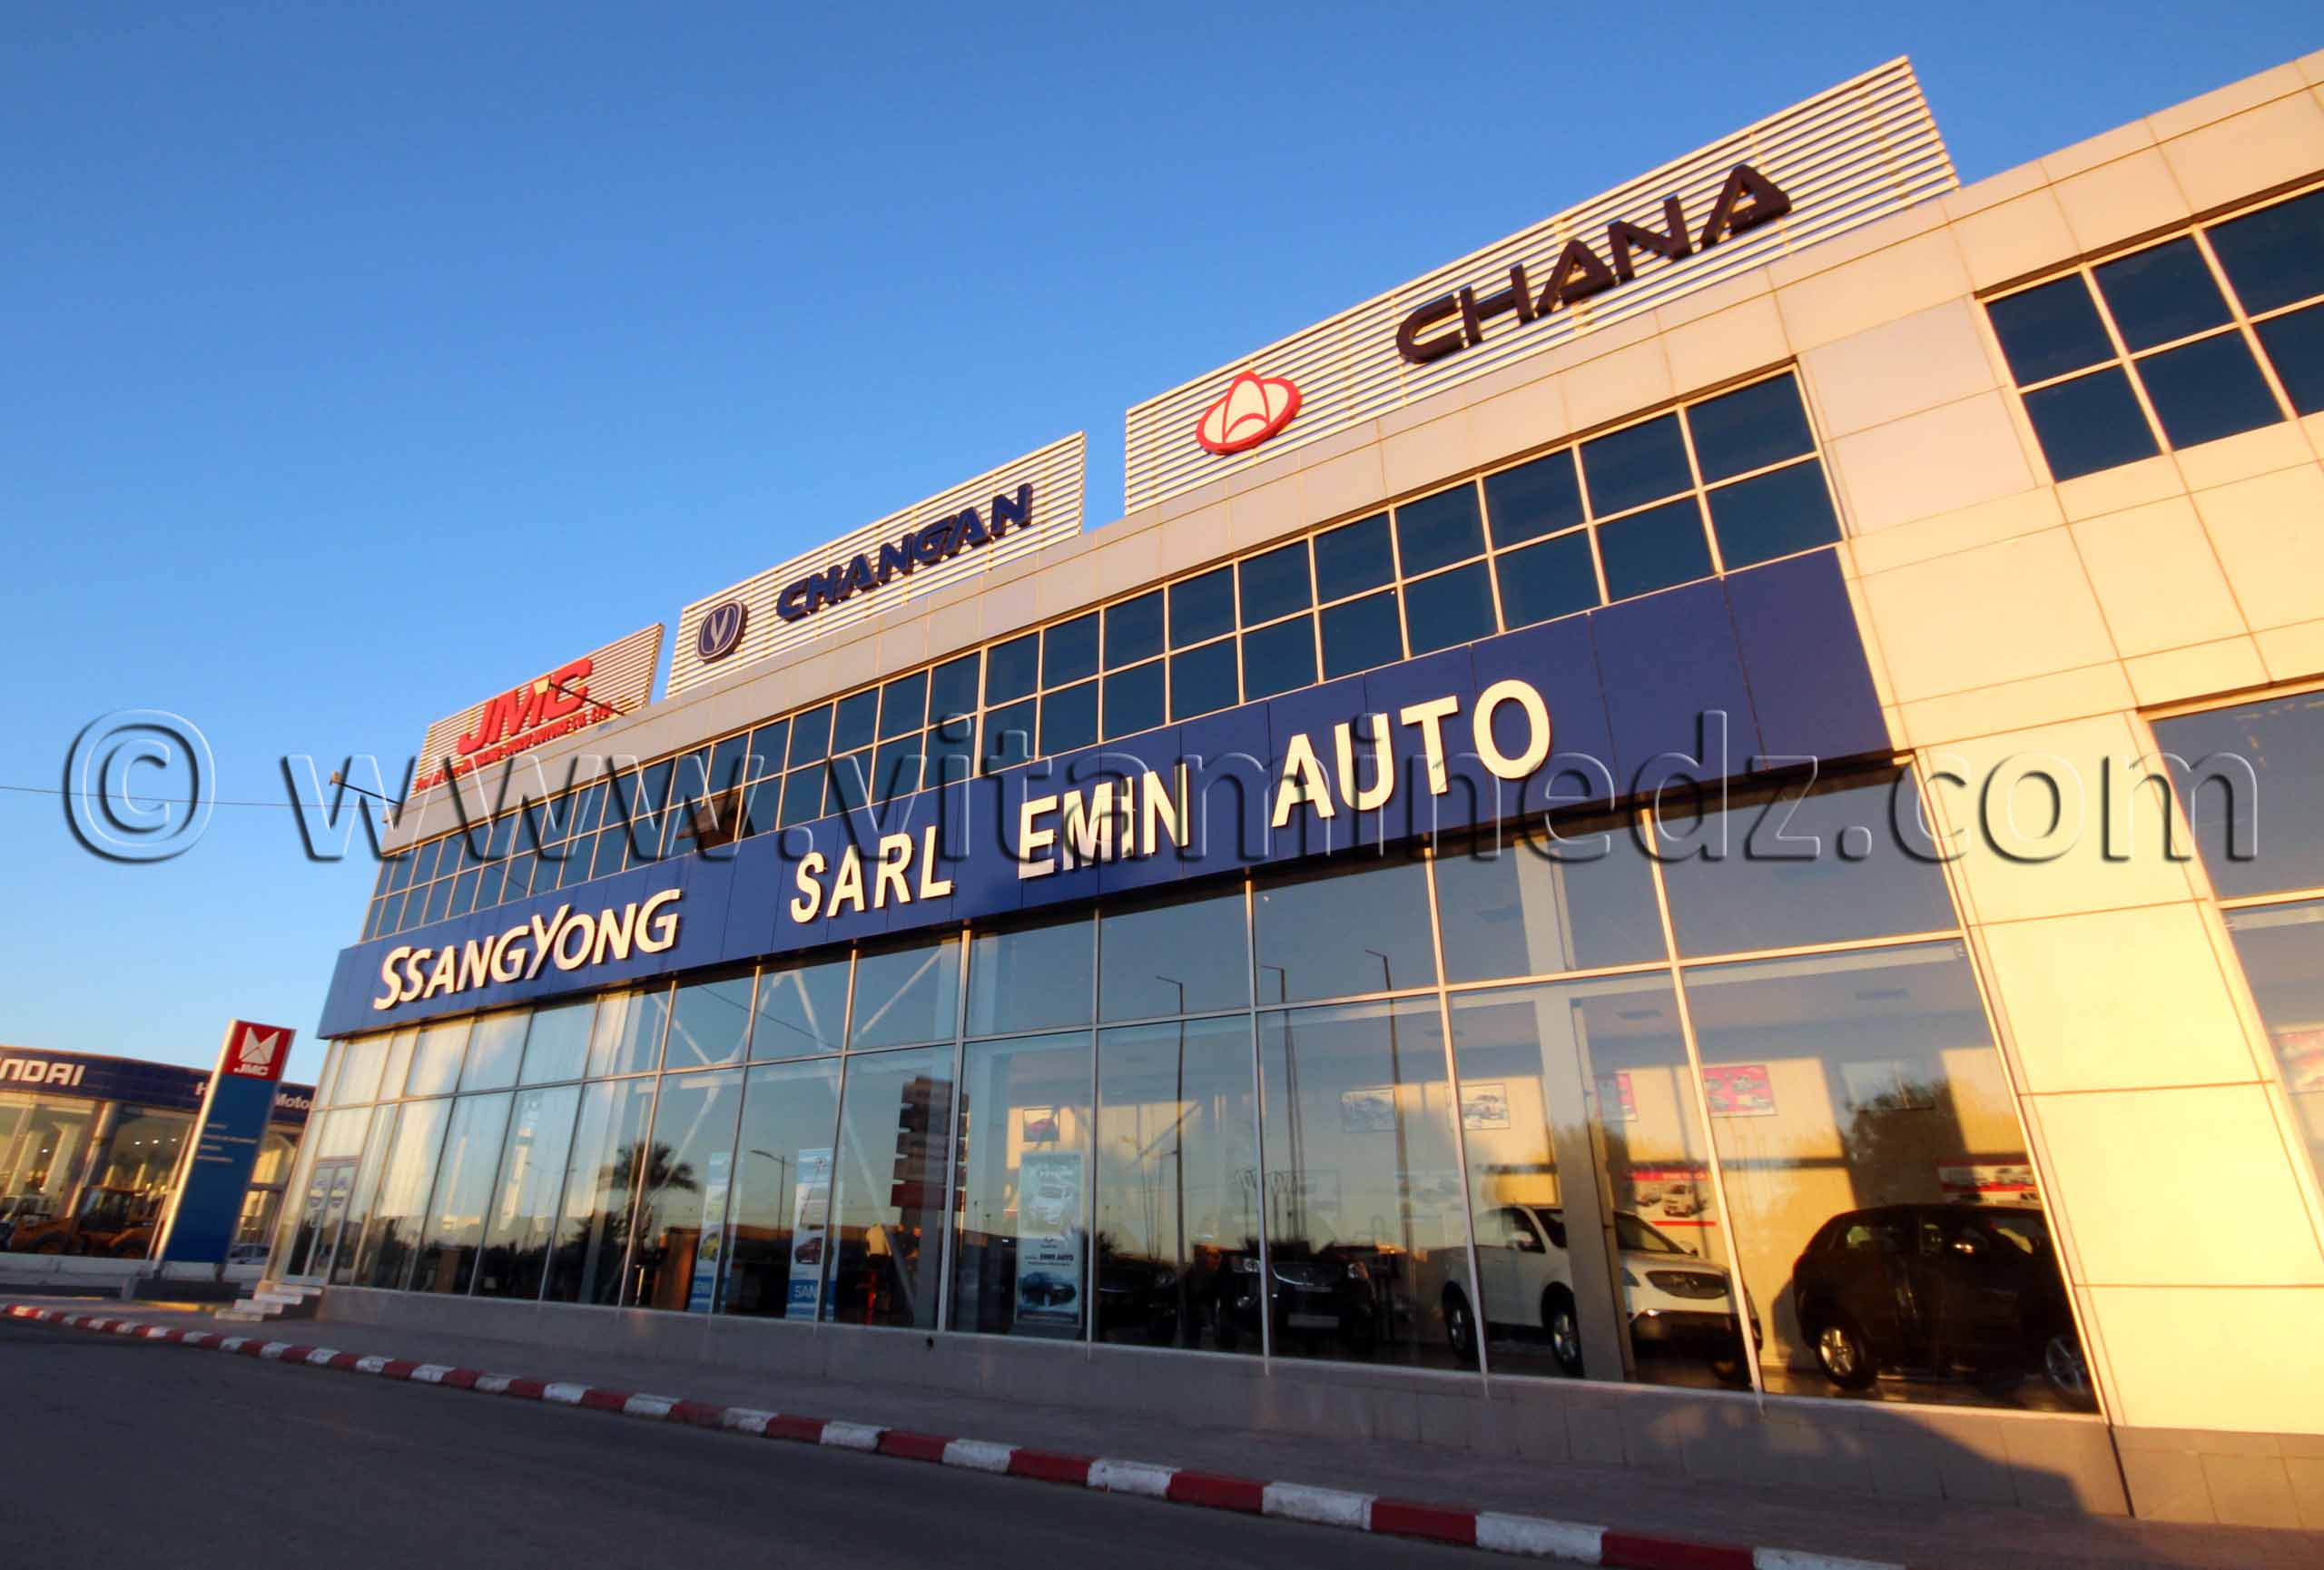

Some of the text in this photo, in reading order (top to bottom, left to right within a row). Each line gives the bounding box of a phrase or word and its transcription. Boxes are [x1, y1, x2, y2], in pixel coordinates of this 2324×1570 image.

[1395, 163, 1792, 364] CHANA
[776, 482, 1033, 621] CHANGAN
[457, 657, 593, 755] JMC
[790, 679, 1551, 923] SARL EMIN AUTO
[373, 888, 681, 1010] SSANGYONG
[0, 1057, 85, 1086] NDAI
[233, 1064, 269, 1076] JMC
